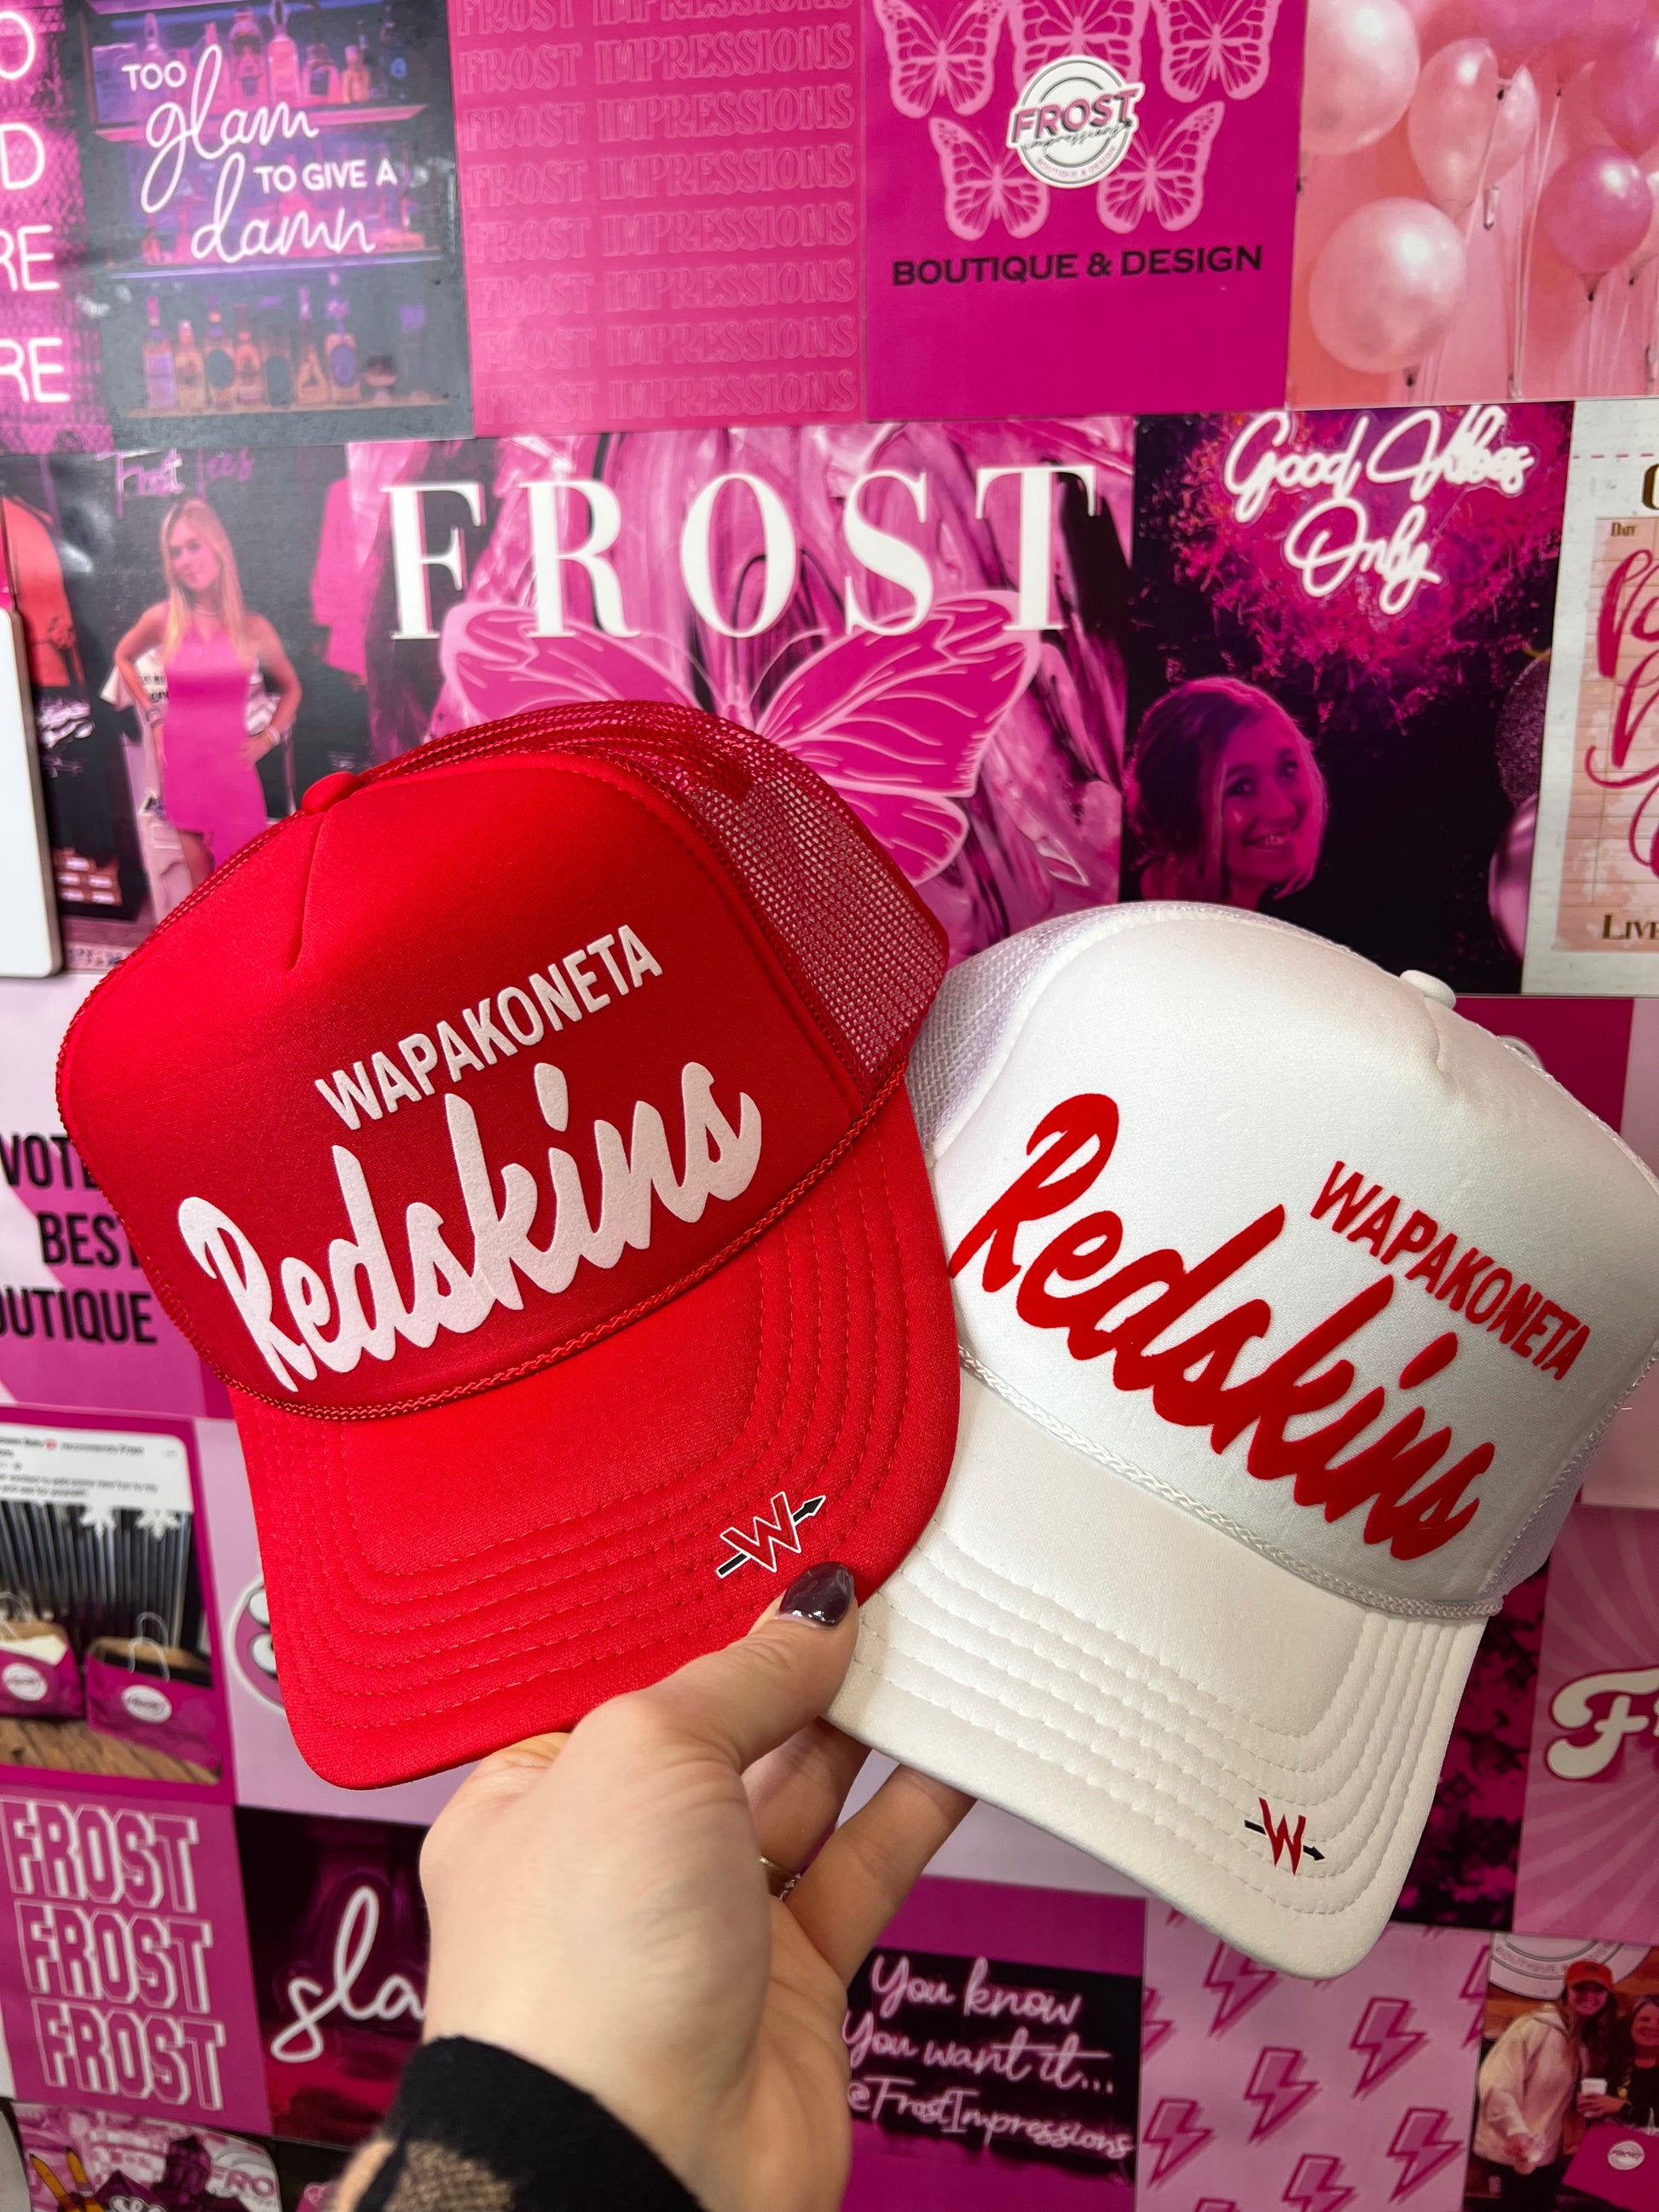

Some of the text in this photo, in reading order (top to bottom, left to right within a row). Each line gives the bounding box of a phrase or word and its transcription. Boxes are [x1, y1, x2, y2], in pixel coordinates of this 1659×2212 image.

[122, 61, 187, 91] TOO
[458, 23, 855, 95] FROST IMPRESSIONS
[141, 43, 320, 214] glam
[462, 83, 856, 152] FROST IMPRESSIONS
[1011, 88, 1141, 143] FROST
[190, 151, 376, 263] damn
[253, 158, 398, 194] TO GIVE A
[465, 142, 856, 208] FROST IMPRESSIONS
[470, 201, 857, 264] FROST IMPRESSIONS
[892, 245, 1263, 286] BOUTIQUE & DESIGN
[473, 258, 858, 320] FROST IMPRESSIONS
[606, 314, 858, 367] IMPRESSIONS
[608, 368, 858, 419] IMPRESSIONS
[1224, 410, 1370, 523] Good
[381, 464, 1098, 640] FROST
[1284, 498, 1442, 615] Only
[315, 924, 663, 1130] WAPAKONETA
[177, 1061, 762, 1393] Redskins
[1309, 1160, 1592, 1381] WAPAKONETA
[0, 1285, 157, 1344] UTIQUE
[949, 1094, 1496, 1561] Redskins
[720, 1490, 801, 1573] W
[1, 1795, 199, 1914] FROST
[1257, 1796, 1307, 1877] W
[14, 1899, 213, 2014] FROST
[870, 1955, 1081, 2025] You know
[32, 1996, 226, 2111] FROST
[842, 2008, 918, 2069] You
[924, 2026, 1060, 2081] want
